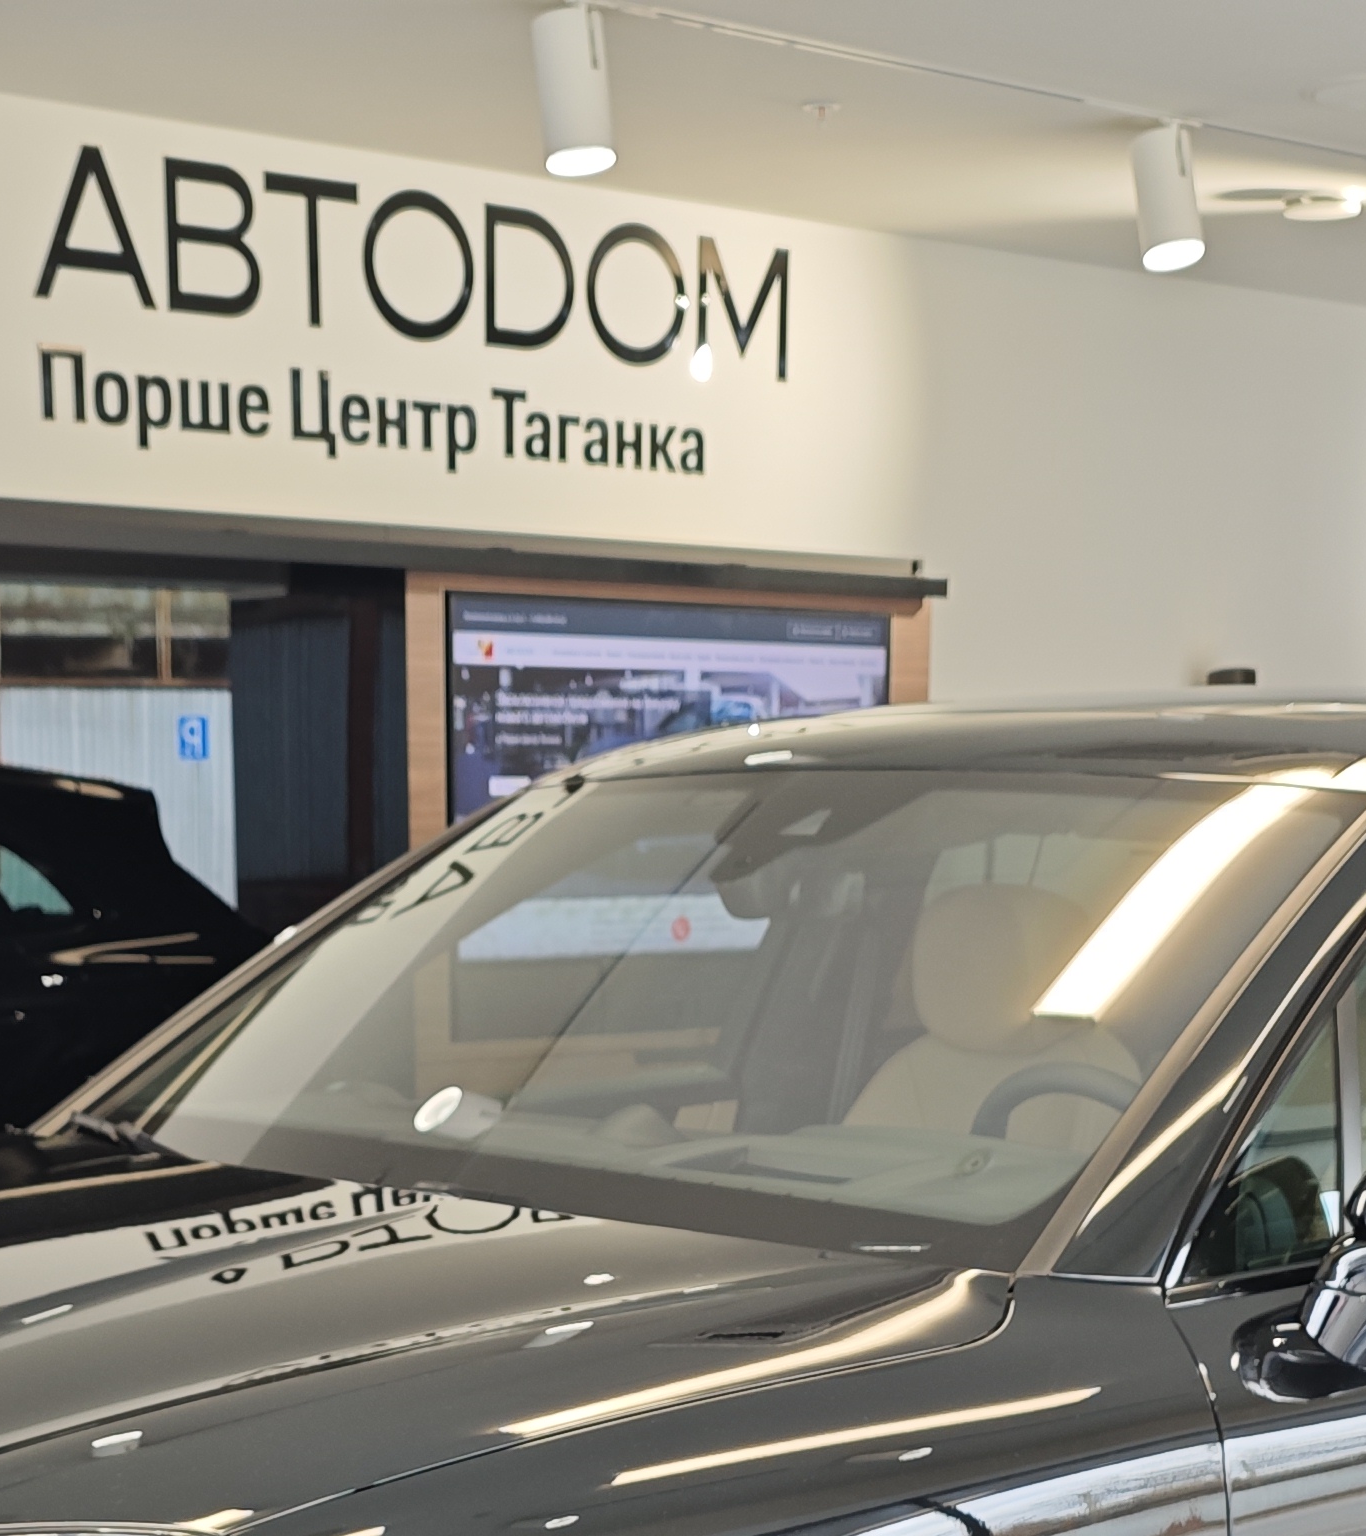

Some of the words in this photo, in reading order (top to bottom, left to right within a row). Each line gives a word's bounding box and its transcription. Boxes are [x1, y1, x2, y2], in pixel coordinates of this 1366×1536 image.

[35, 145, 789, 382] ABTODOM
[37, 343, 272, 449] Порше
[290, 367, 477, 474] Центр
[492, 387, 706, 475] Таганка
